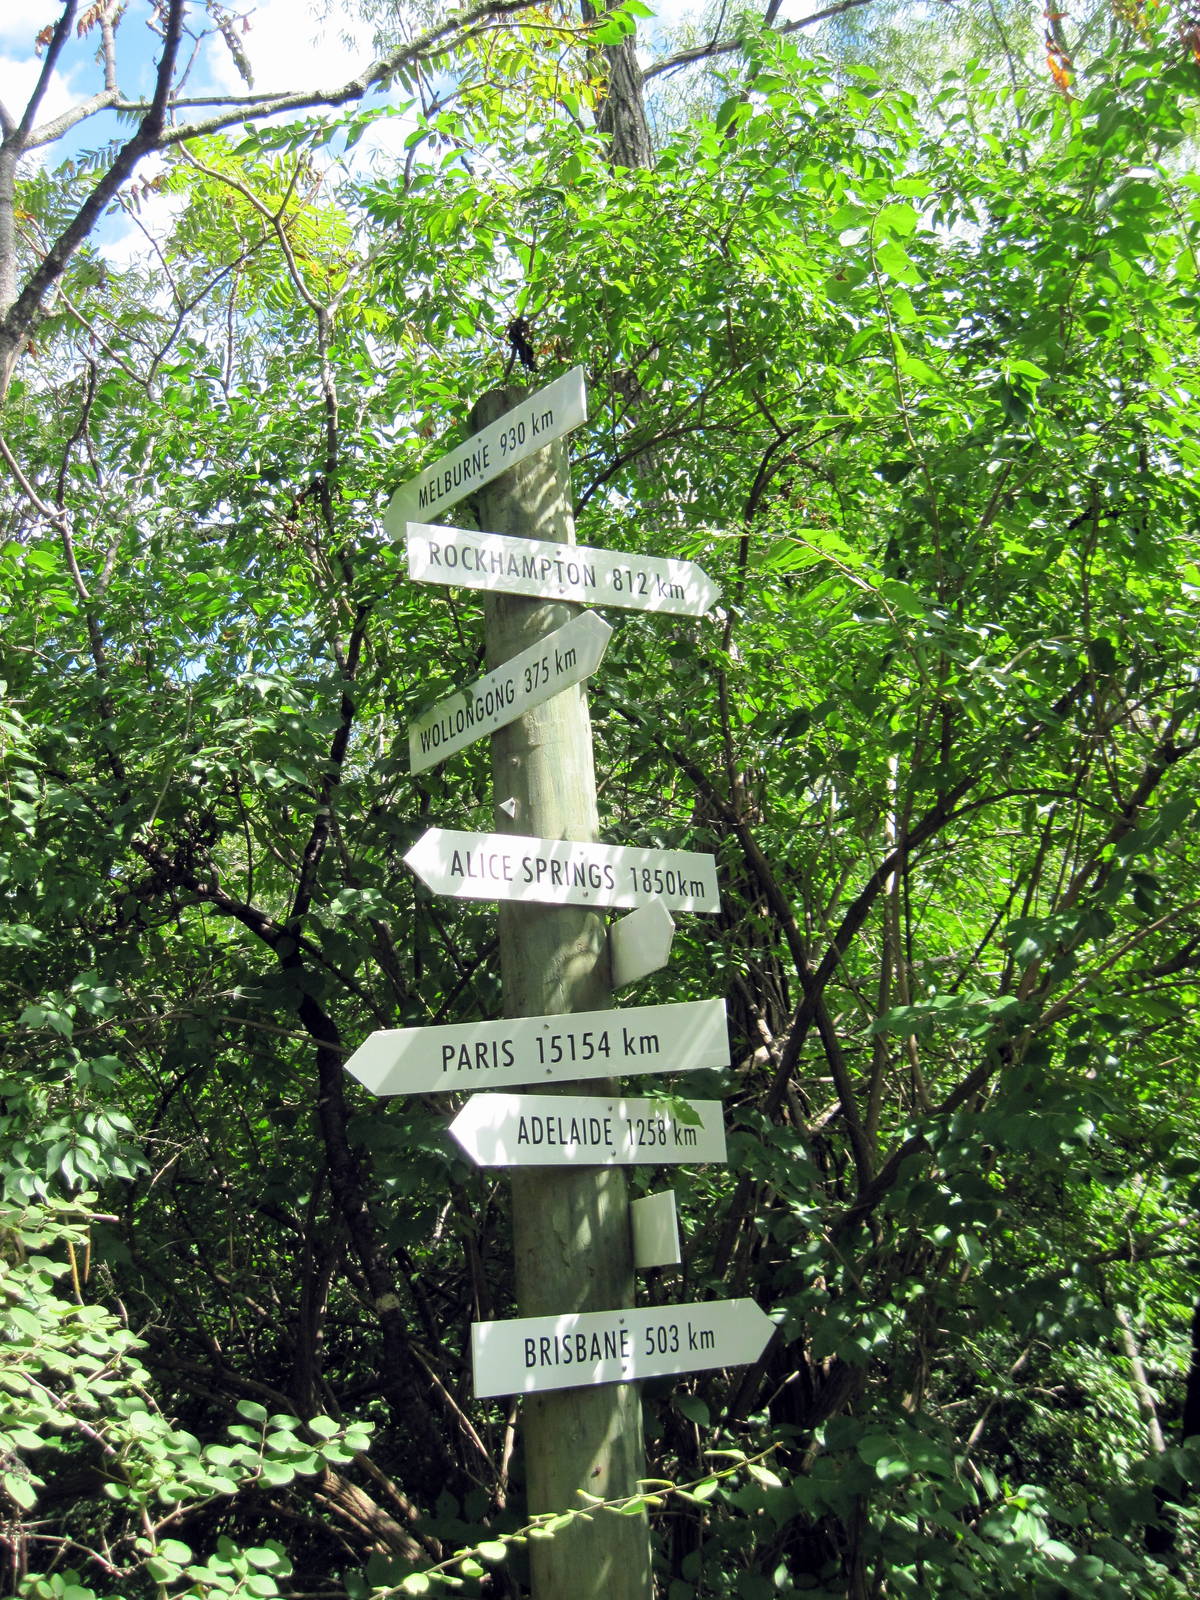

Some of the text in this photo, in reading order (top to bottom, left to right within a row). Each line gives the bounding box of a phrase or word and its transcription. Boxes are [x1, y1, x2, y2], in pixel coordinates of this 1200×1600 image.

[418, 408, 554, 510] MELBURNE 930 km
[428, 541, 685, 600] ROCKHAMPTON 812 km
[420, 647, 577, 753] WOLLONGONG 375 km
[450, 850, 513, 881] ALICE
[522, 856, 615, 890] SPRINGS
[442, 1028, 660, 1072] PARIS 15154 km
[517, 1116, 697, 1147] ADELAIDE 1258 km
[524, 1321, 715, 1368] BRISBANE 503 km
